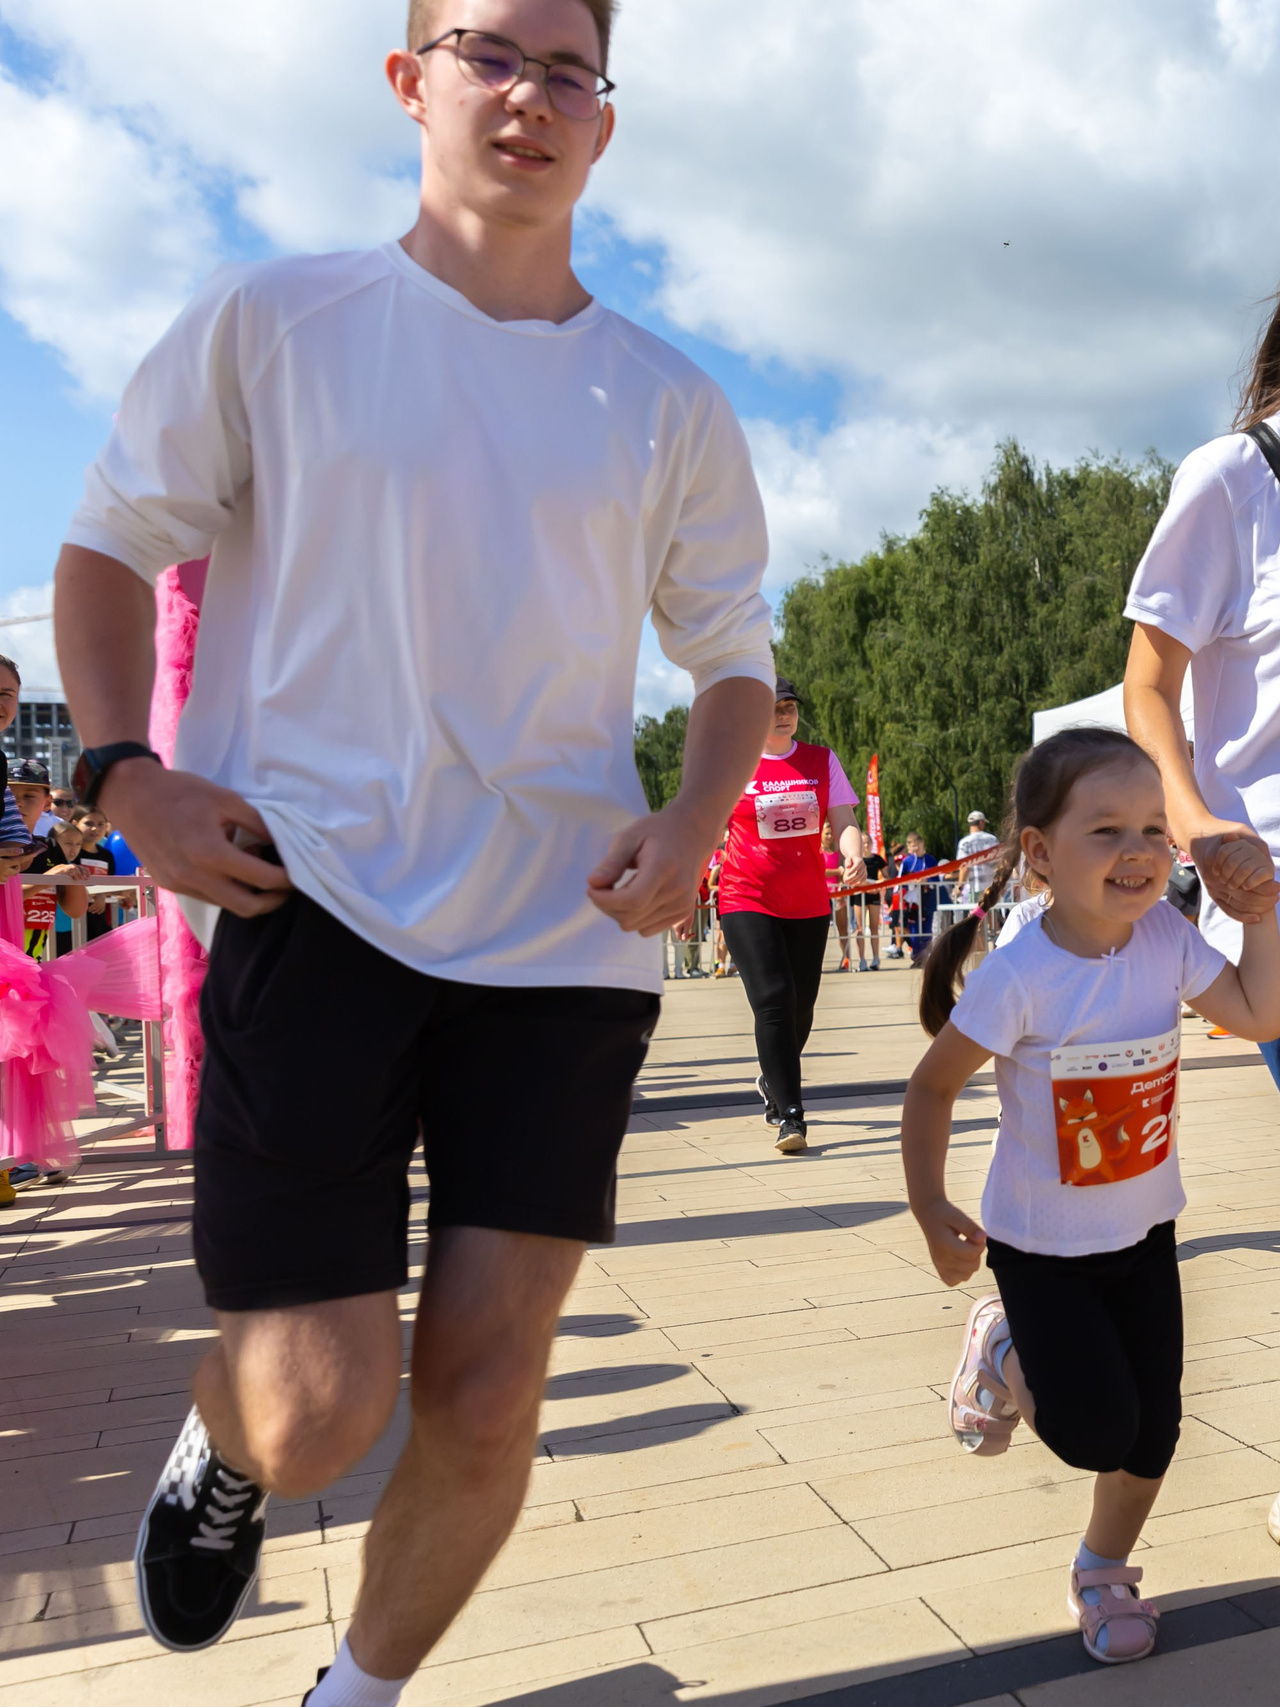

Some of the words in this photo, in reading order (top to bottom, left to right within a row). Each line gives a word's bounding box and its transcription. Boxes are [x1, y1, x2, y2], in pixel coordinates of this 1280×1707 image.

[762, 779, 819, 787] КАЛАШНИКОВ
[774, 817, 807, 832] 88
[27, 909, 56, 923] 225
